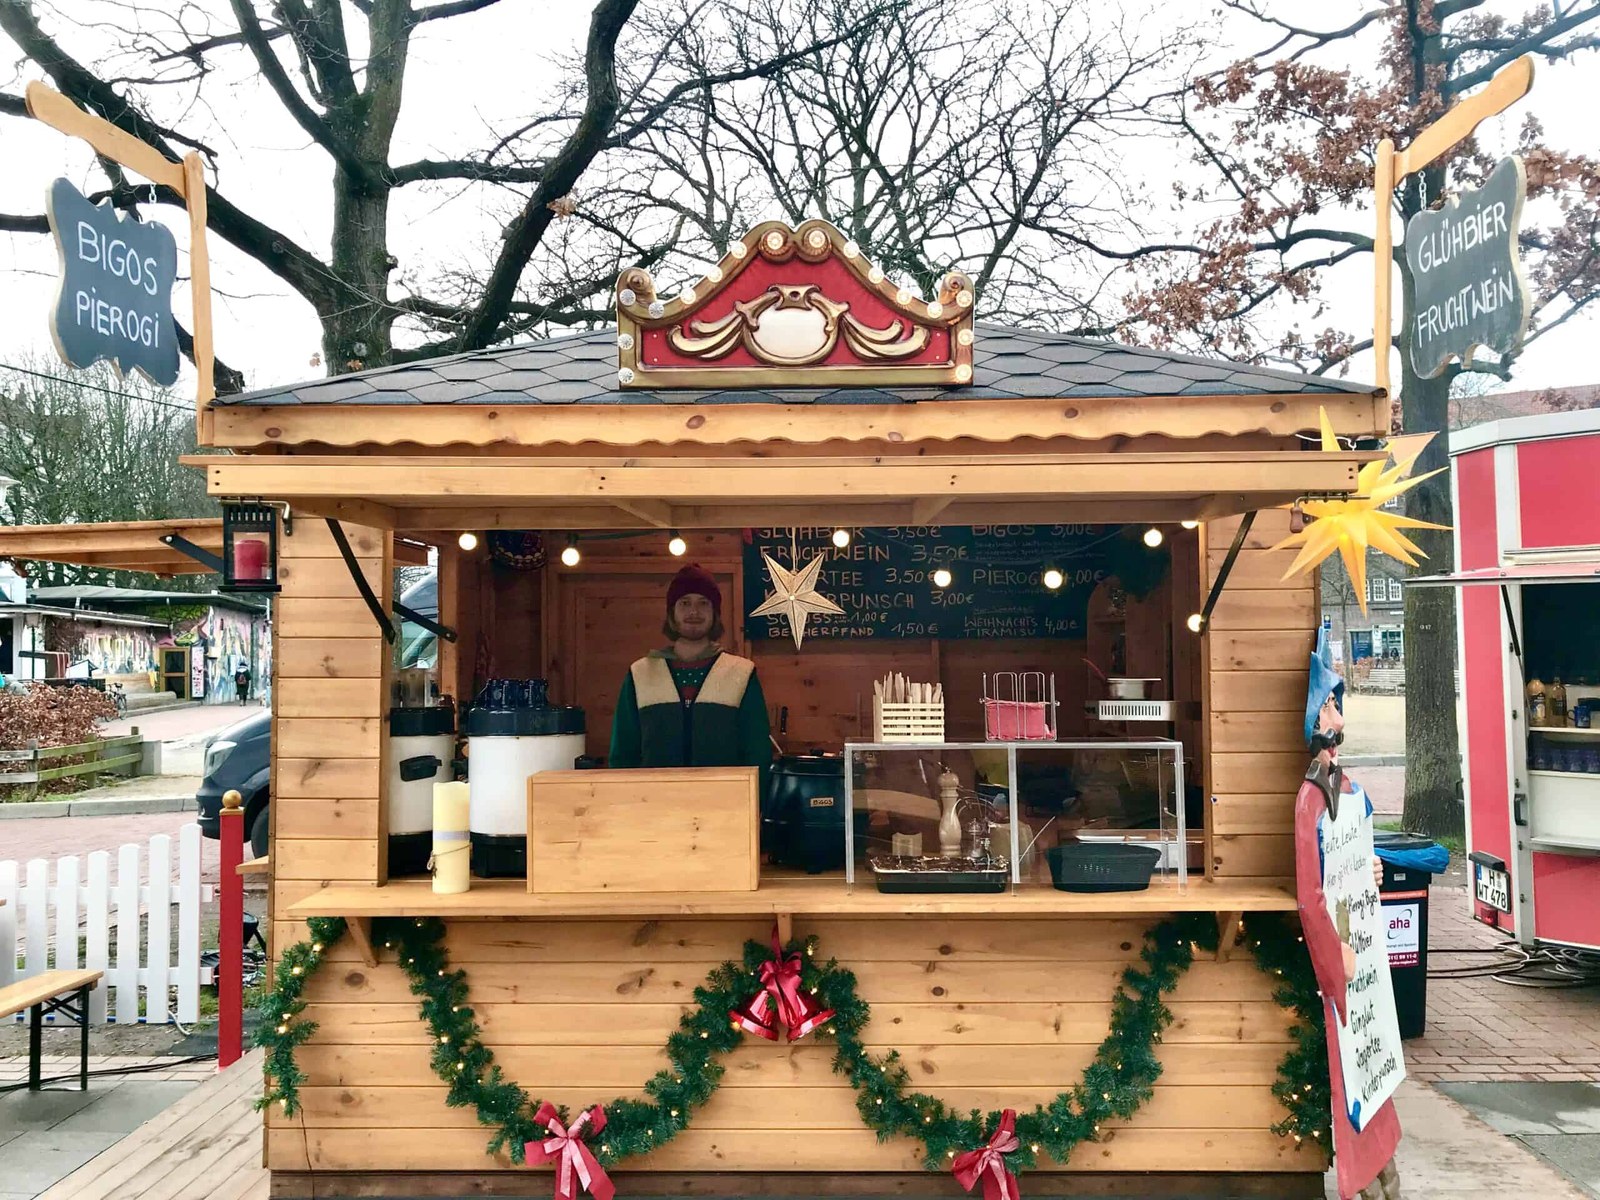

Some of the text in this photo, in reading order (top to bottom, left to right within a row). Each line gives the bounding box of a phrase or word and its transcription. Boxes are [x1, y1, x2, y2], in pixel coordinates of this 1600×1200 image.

[77, 221, 158, 295] BIGOS
[769, 626, 874, 638] BEHERPFAND
[1489, 869, 1495, 887] H
[1491, 889, 1506, 909] 478
[1389, 917, 1411, 930] aha
